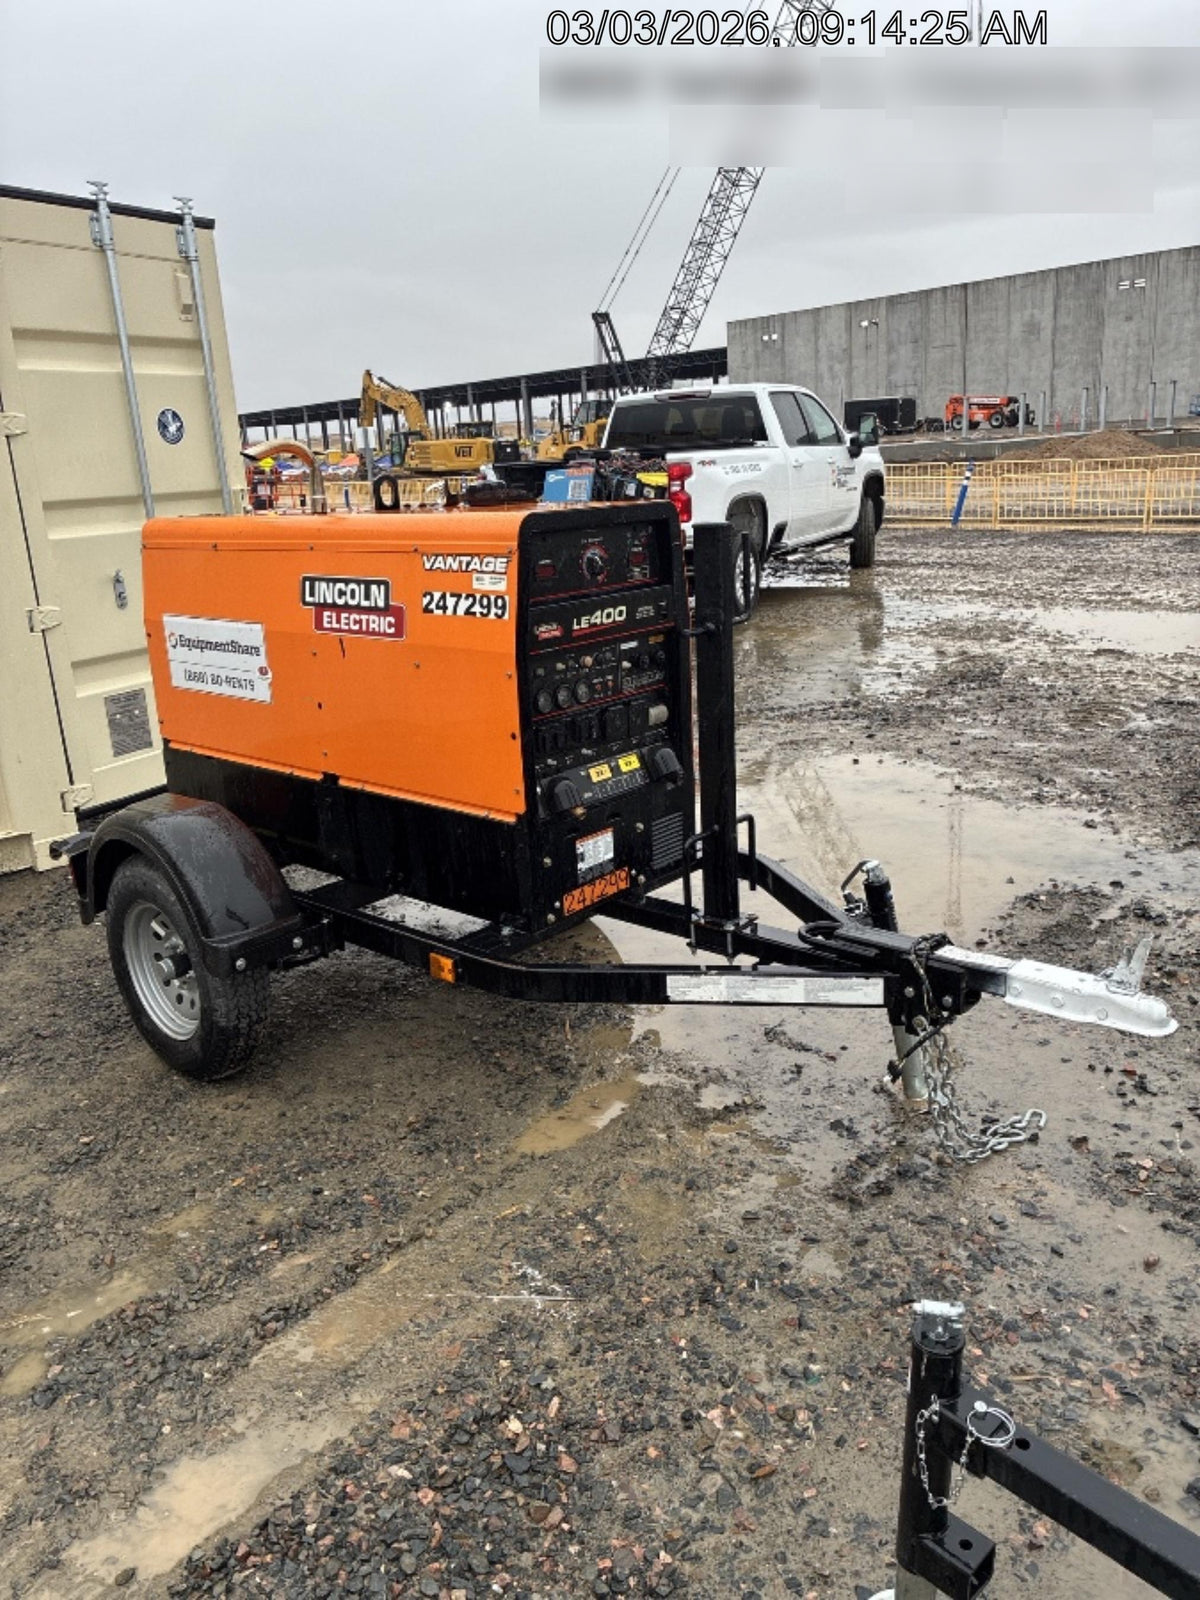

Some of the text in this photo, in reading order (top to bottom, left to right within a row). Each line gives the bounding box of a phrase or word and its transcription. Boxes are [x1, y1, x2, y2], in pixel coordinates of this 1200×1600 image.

[422, 555, 510, 573] VANTAGE
[304, 580, 385, 608] LINCOLN
[422, 591, 508, 619] 247299
[322, 611, 395, 634] ELECTRIC
[572, 605, 627, 631] LE400
[178, 634, 261, 657] EquipmentShare
[564, 869, 629, 913] 247299
